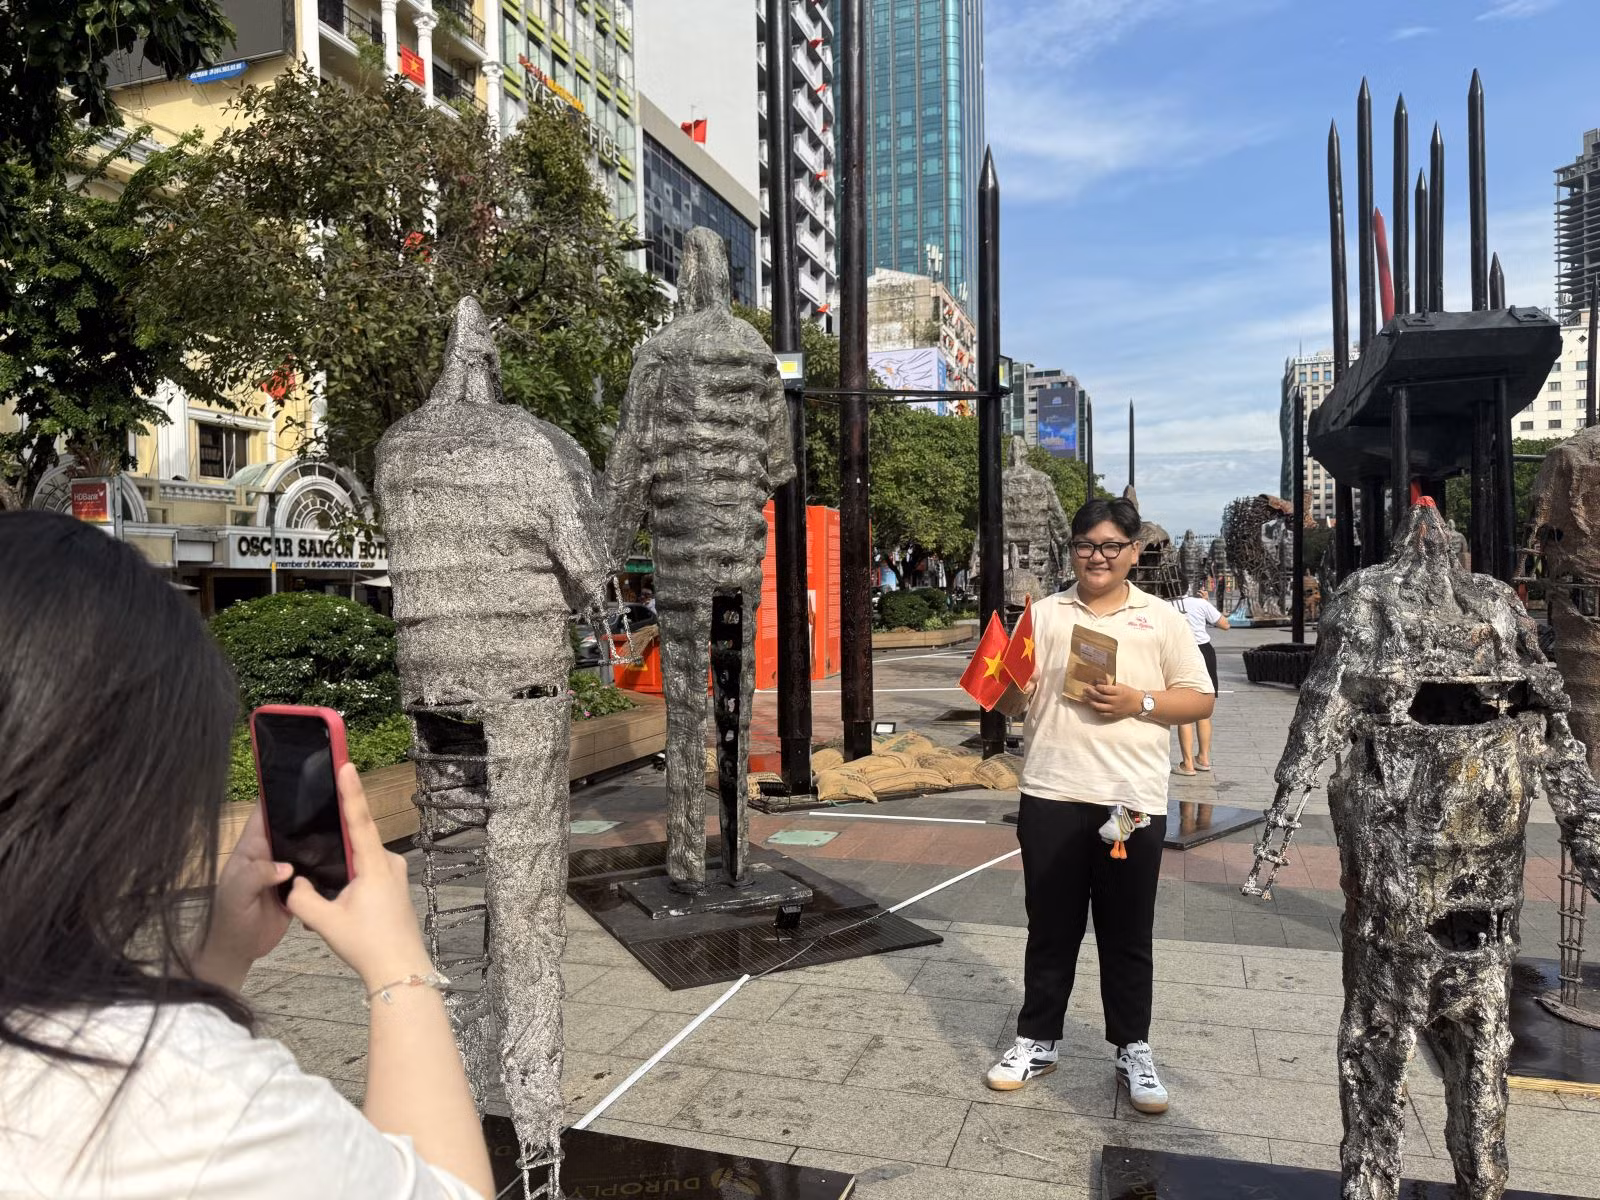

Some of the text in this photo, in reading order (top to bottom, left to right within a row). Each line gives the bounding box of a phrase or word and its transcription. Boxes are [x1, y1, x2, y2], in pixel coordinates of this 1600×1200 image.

[73, 493, 98, 501] HDBank
[238, 536, 293, 557] OSCAR
[298, 538, 354, 559] SAIGON
[277, 560, 303, 568] member
[304, 560, 310, 568] of
[569, 1177, 700, 1199] DUROPLY
